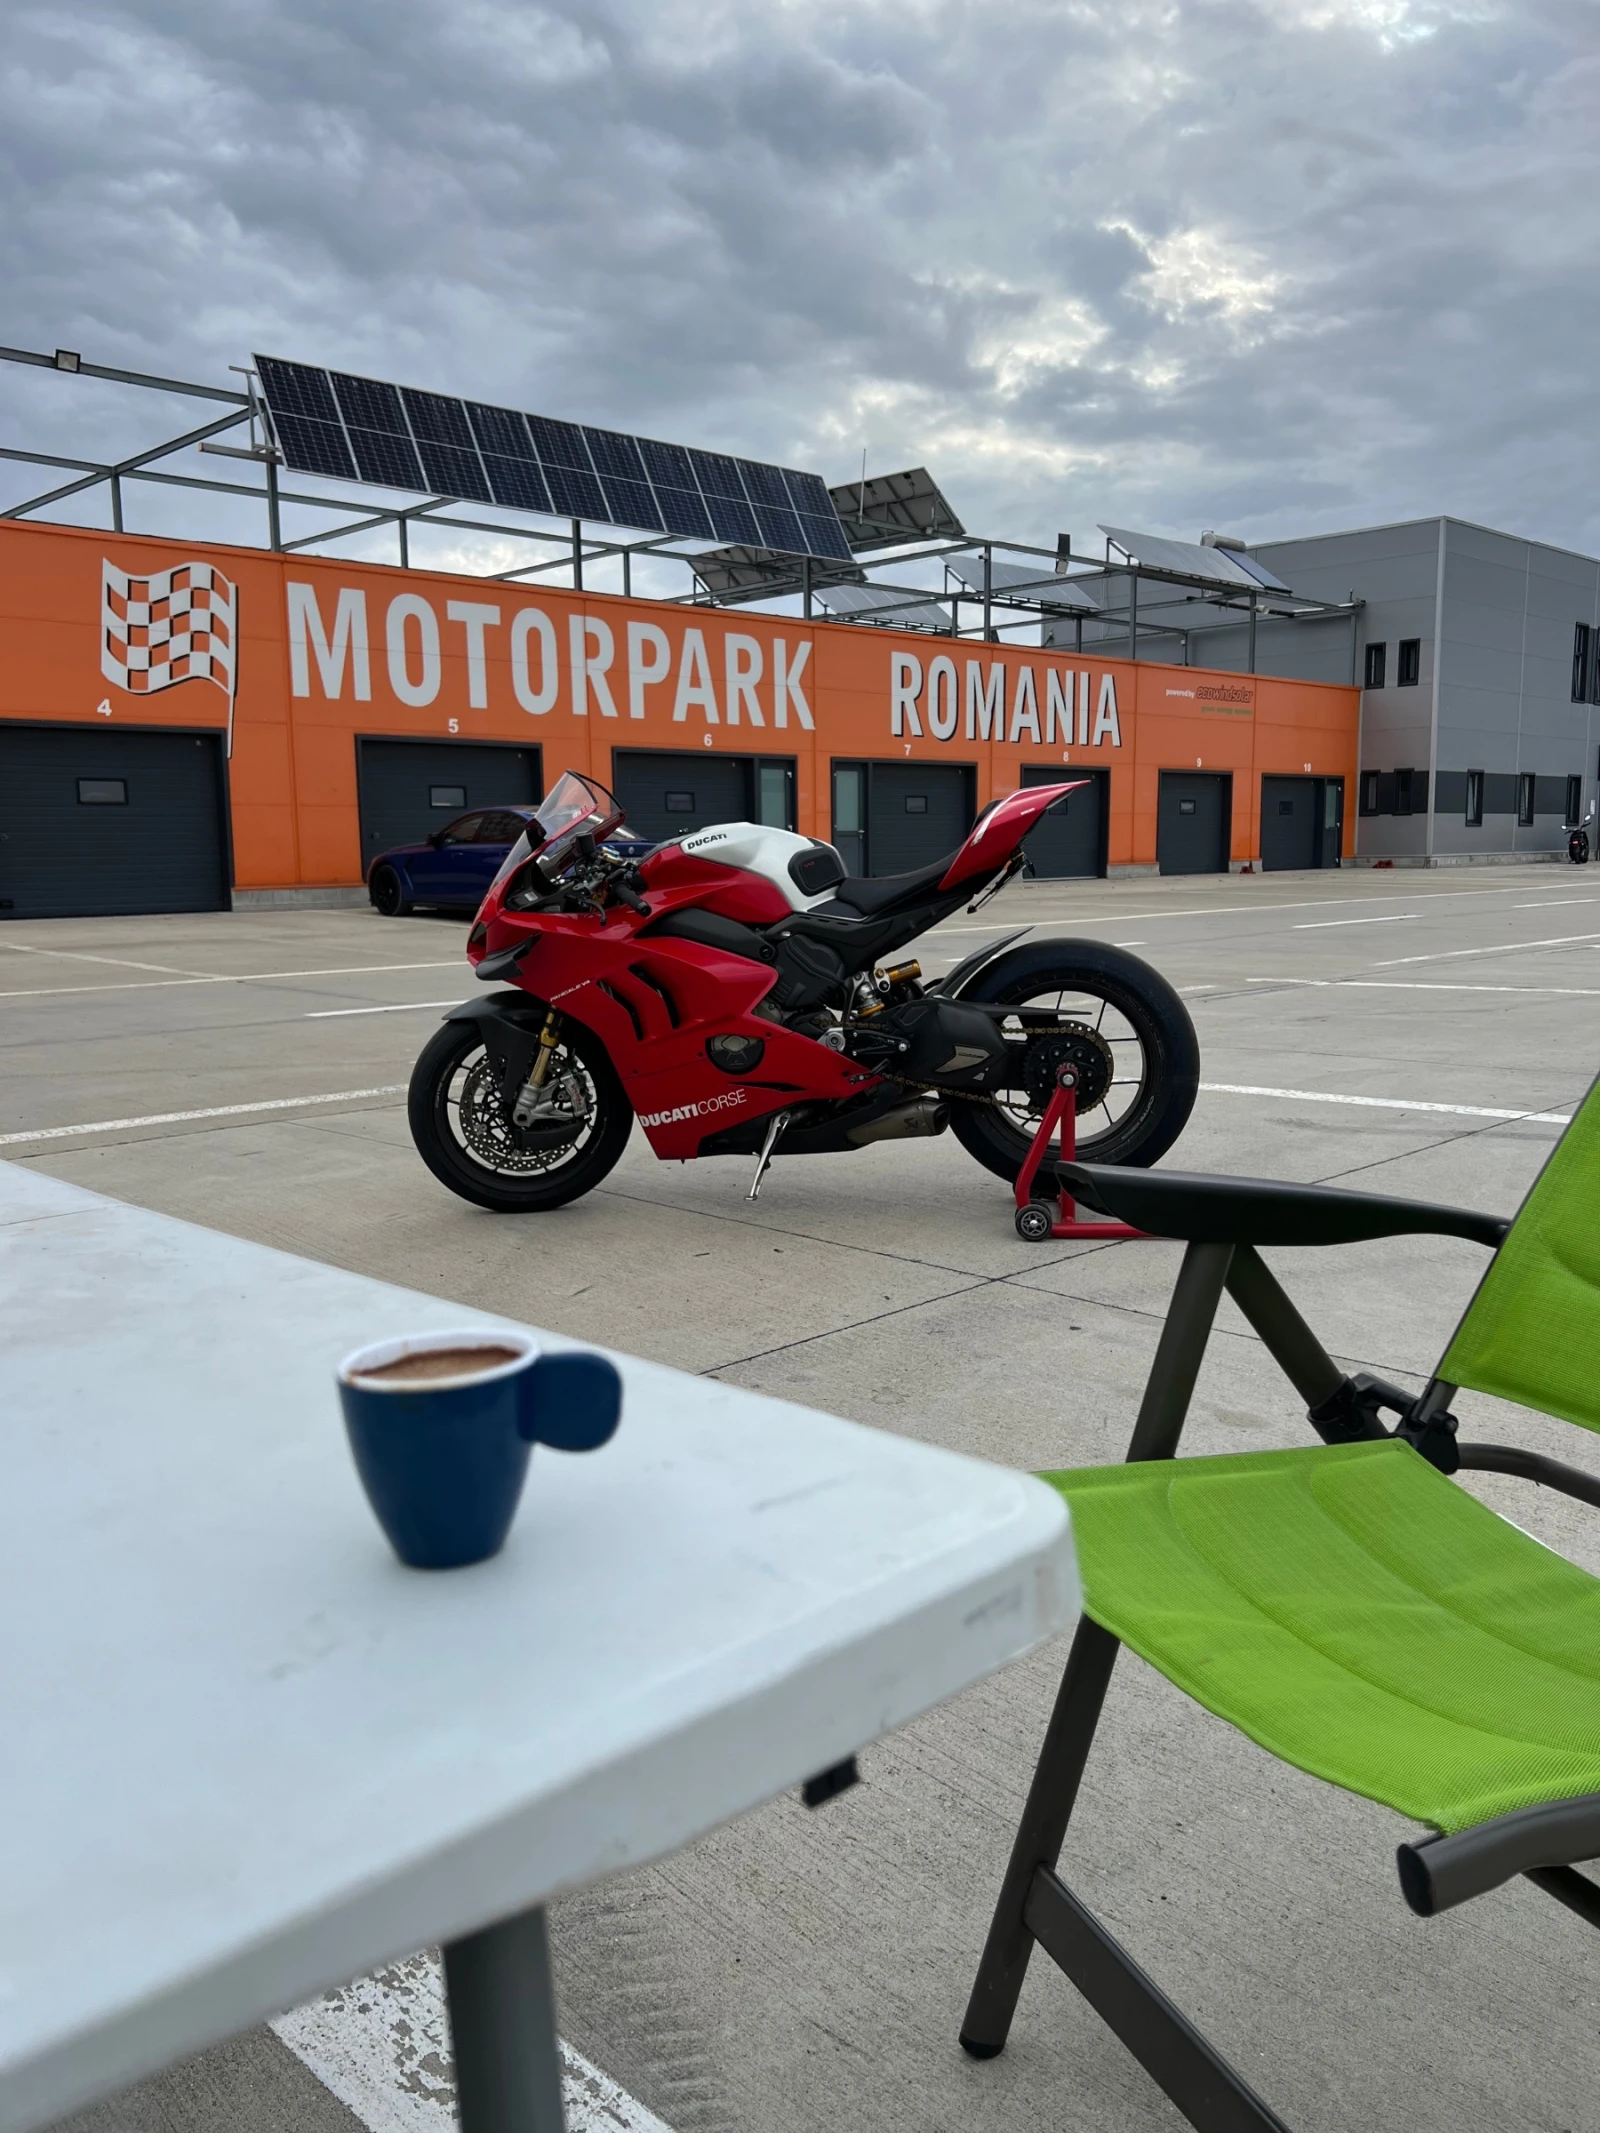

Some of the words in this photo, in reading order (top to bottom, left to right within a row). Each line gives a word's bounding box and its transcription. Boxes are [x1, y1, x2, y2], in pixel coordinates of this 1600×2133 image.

[287, 581, 816, 730] MOTORPARK
[891, 651, 1122, 747] ROMANIA
[96, 698, 113, 717] 4
[448, 718, 460, 734] 5
[703, 733, 713, 746] 6
[904, 744, 912, 756] 7
[1063, 751, 1070, 763] 8
[1196, 757, 1202, 768] 9
[1303, 762, 1312, 773] 10
[687, 833, 728, 850] DUCATI
